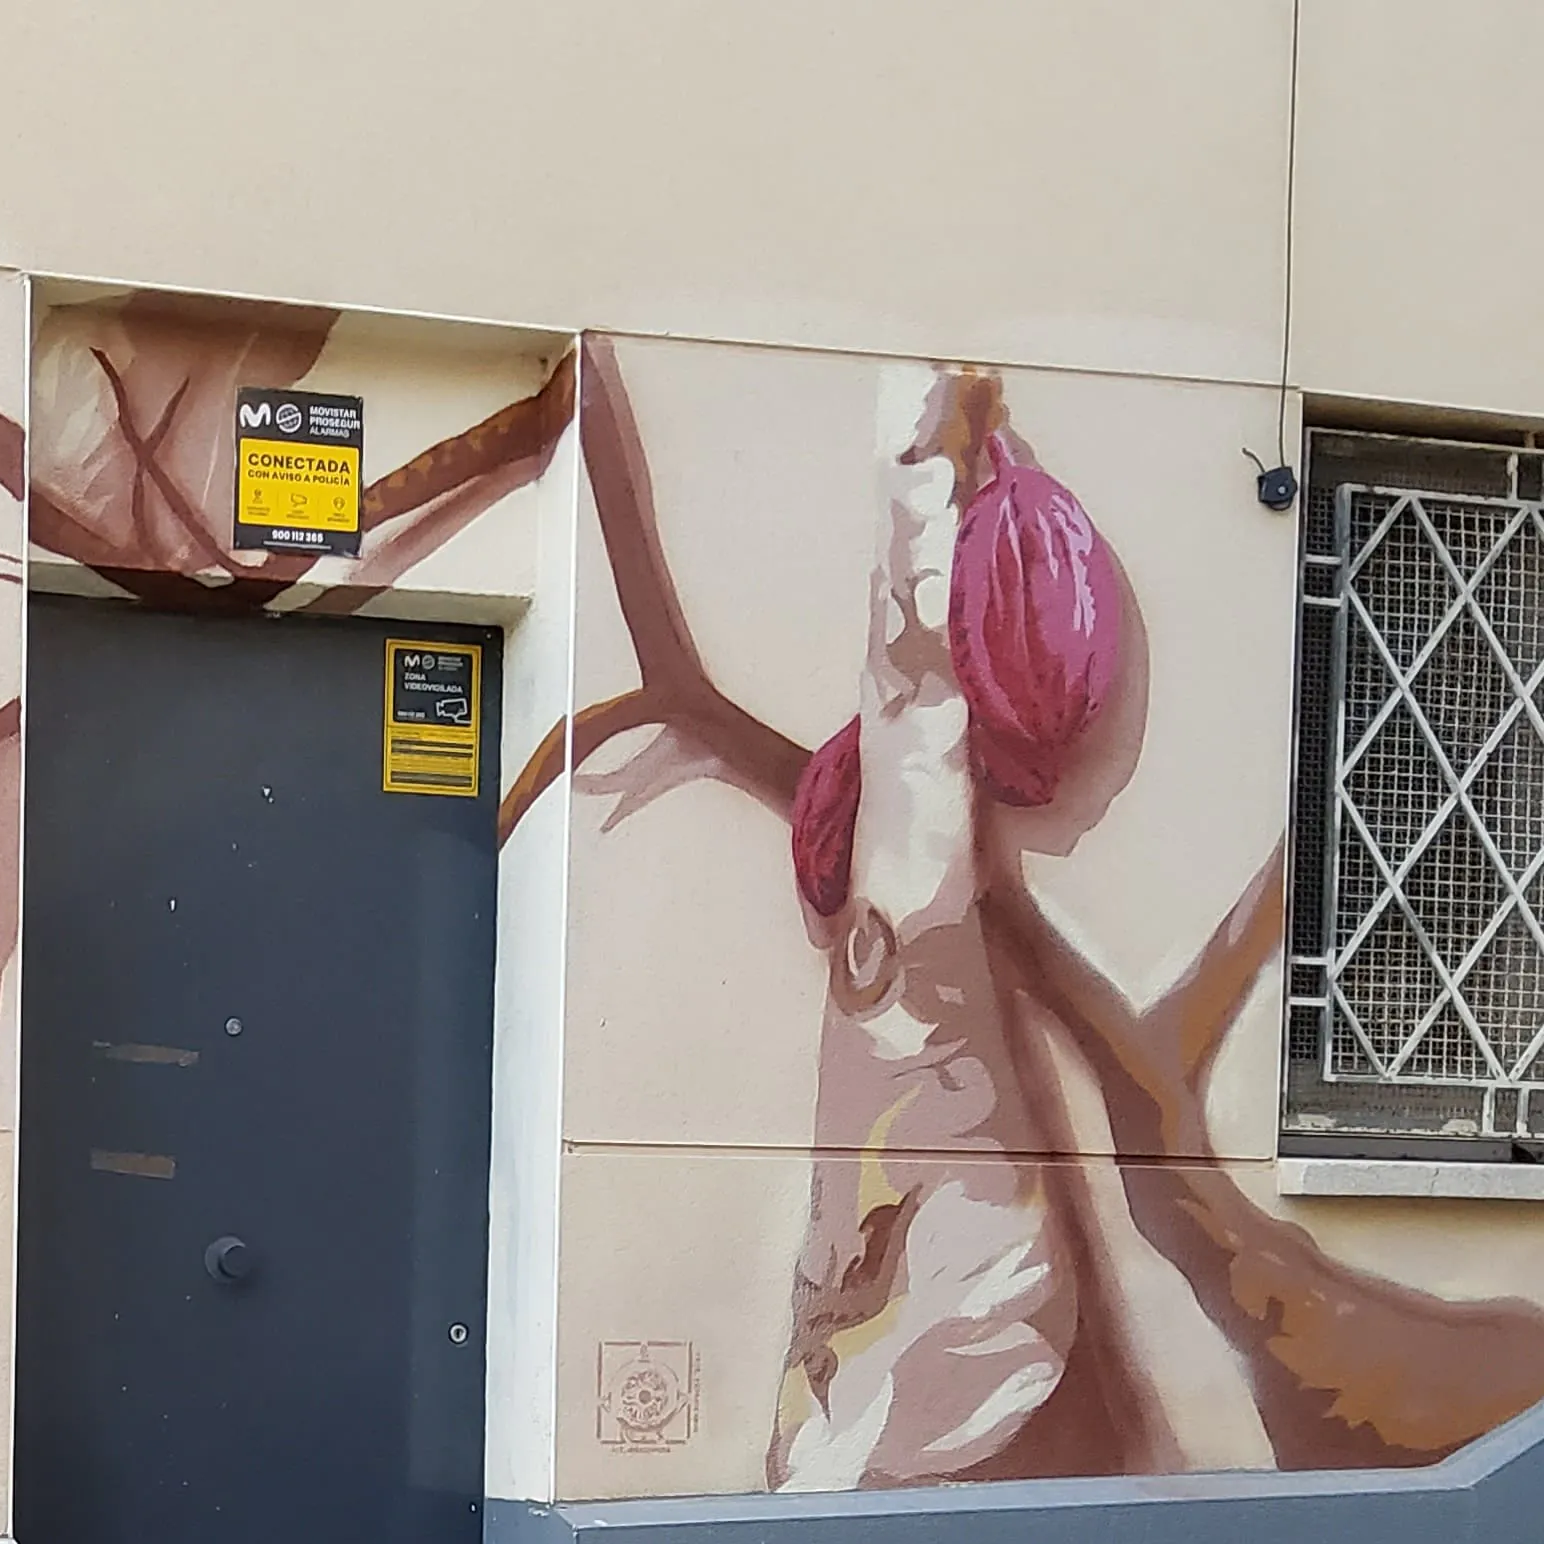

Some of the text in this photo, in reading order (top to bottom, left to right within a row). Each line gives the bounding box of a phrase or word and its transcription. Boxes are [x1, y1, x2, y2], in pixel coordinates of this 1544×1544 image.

[309, 406, 356, 419] MOVISTAR
[309, 416, 361, 430] PROSEGUR
[309, 426, 350, 439] ALARMAS
[248, 453, 350, 474] CONECTADA
[247, 469, 351, 487] CON AVISO A POLICÍA
[272, 529, 290, 541] 900
[404, 671, 426, 681] ZONA
[403, 682, 463, 694] VIDEOVIGILADA
